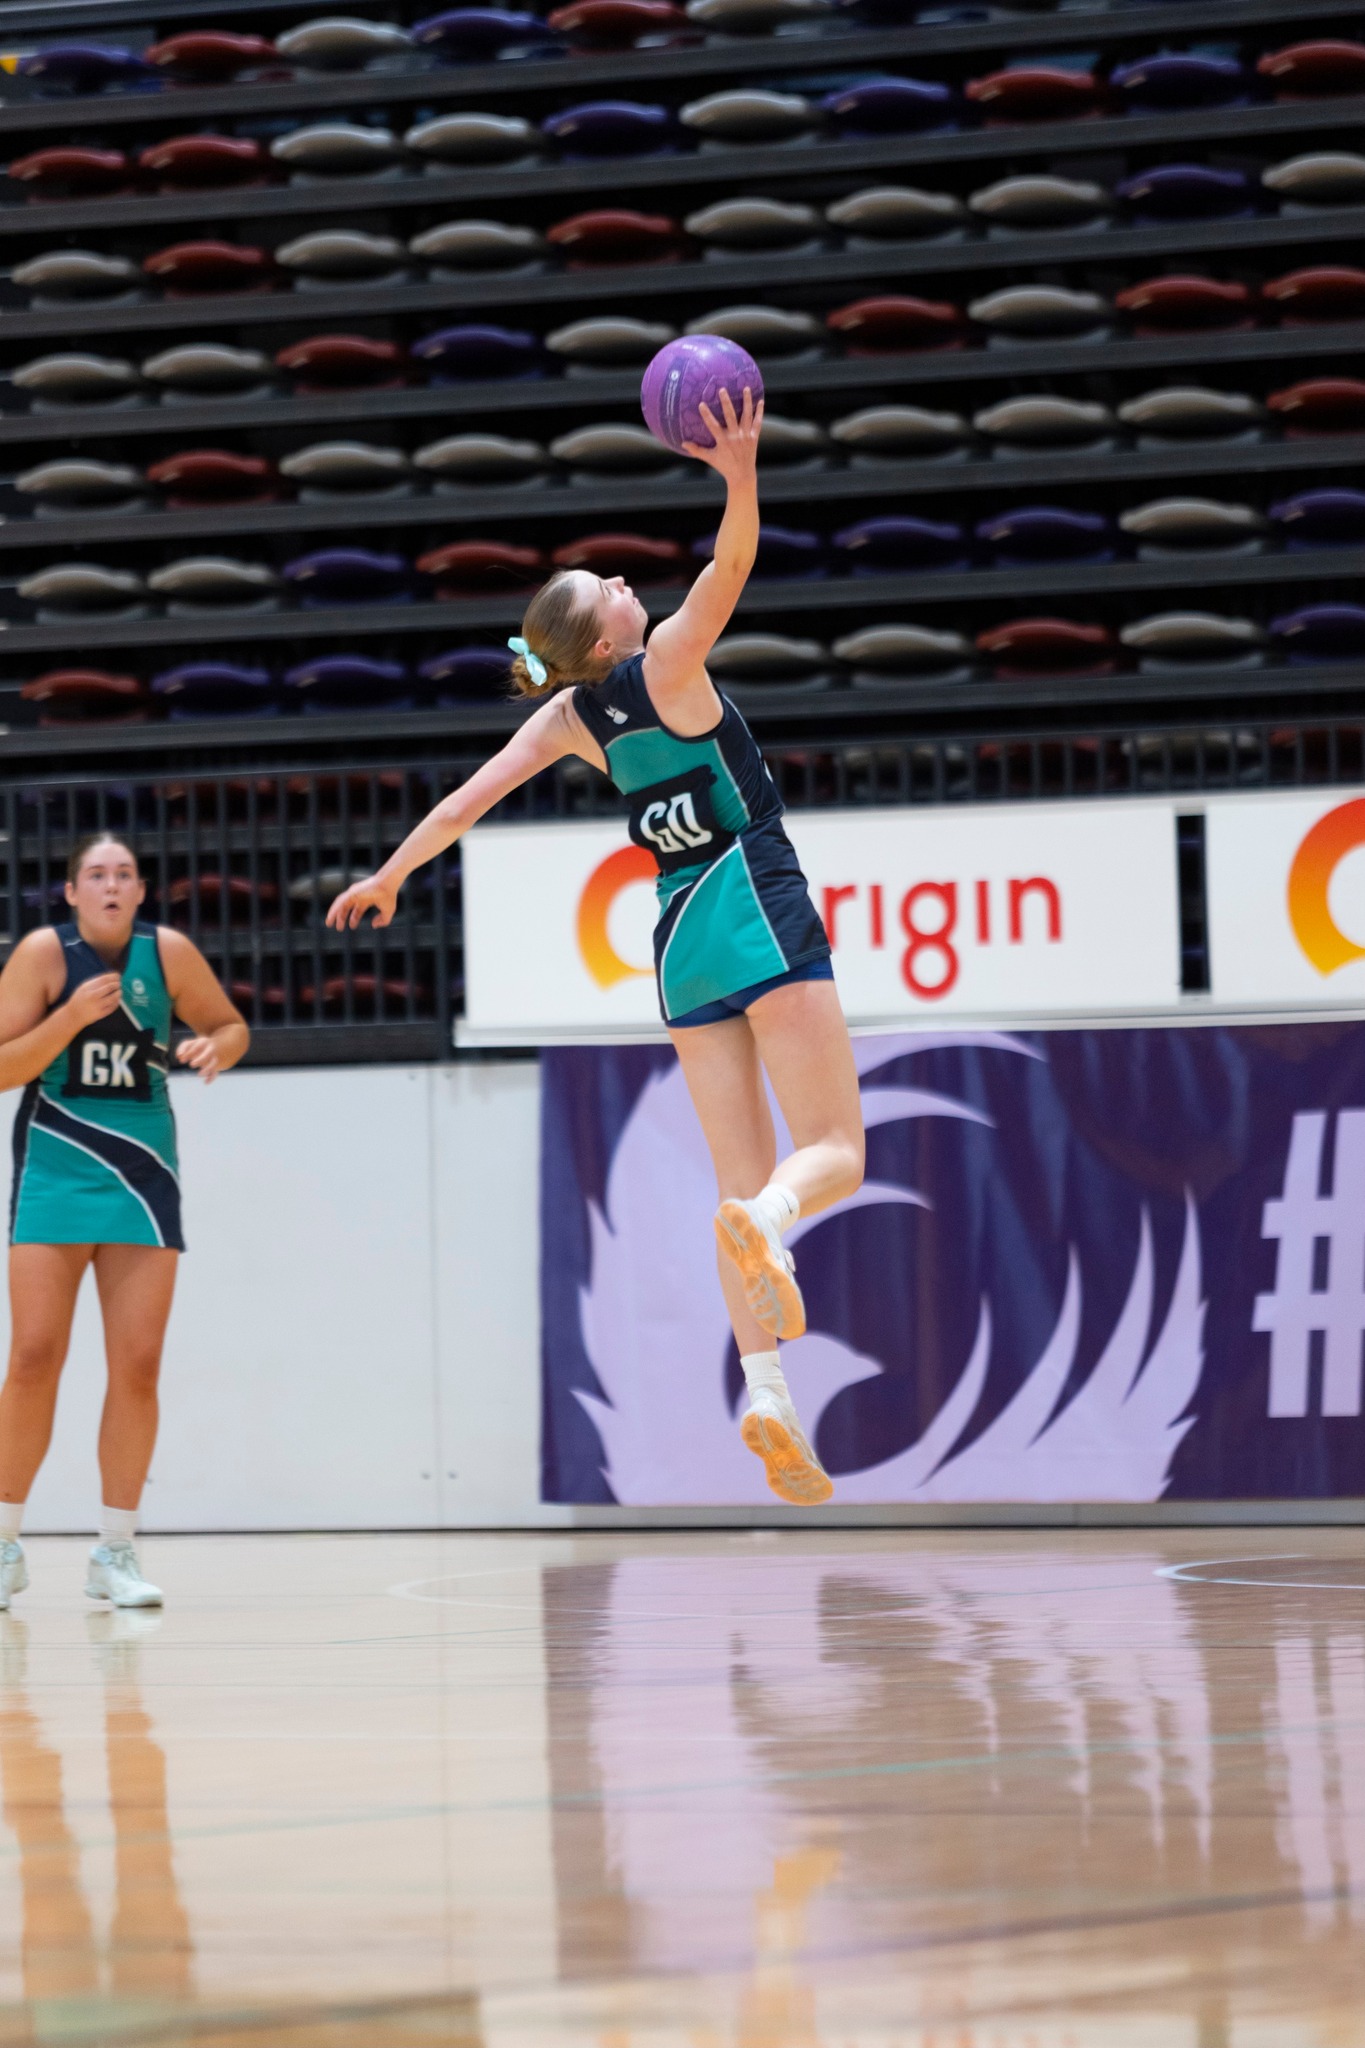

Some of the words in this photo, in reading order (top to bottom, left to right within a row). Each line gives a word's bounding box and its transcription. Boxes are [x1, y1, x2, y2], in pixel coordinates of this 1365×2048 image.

[640, 792, 712, 853] GD
[821, 876, 1062, 1002] rigin
[80, 1040, 138, 1088] GK
